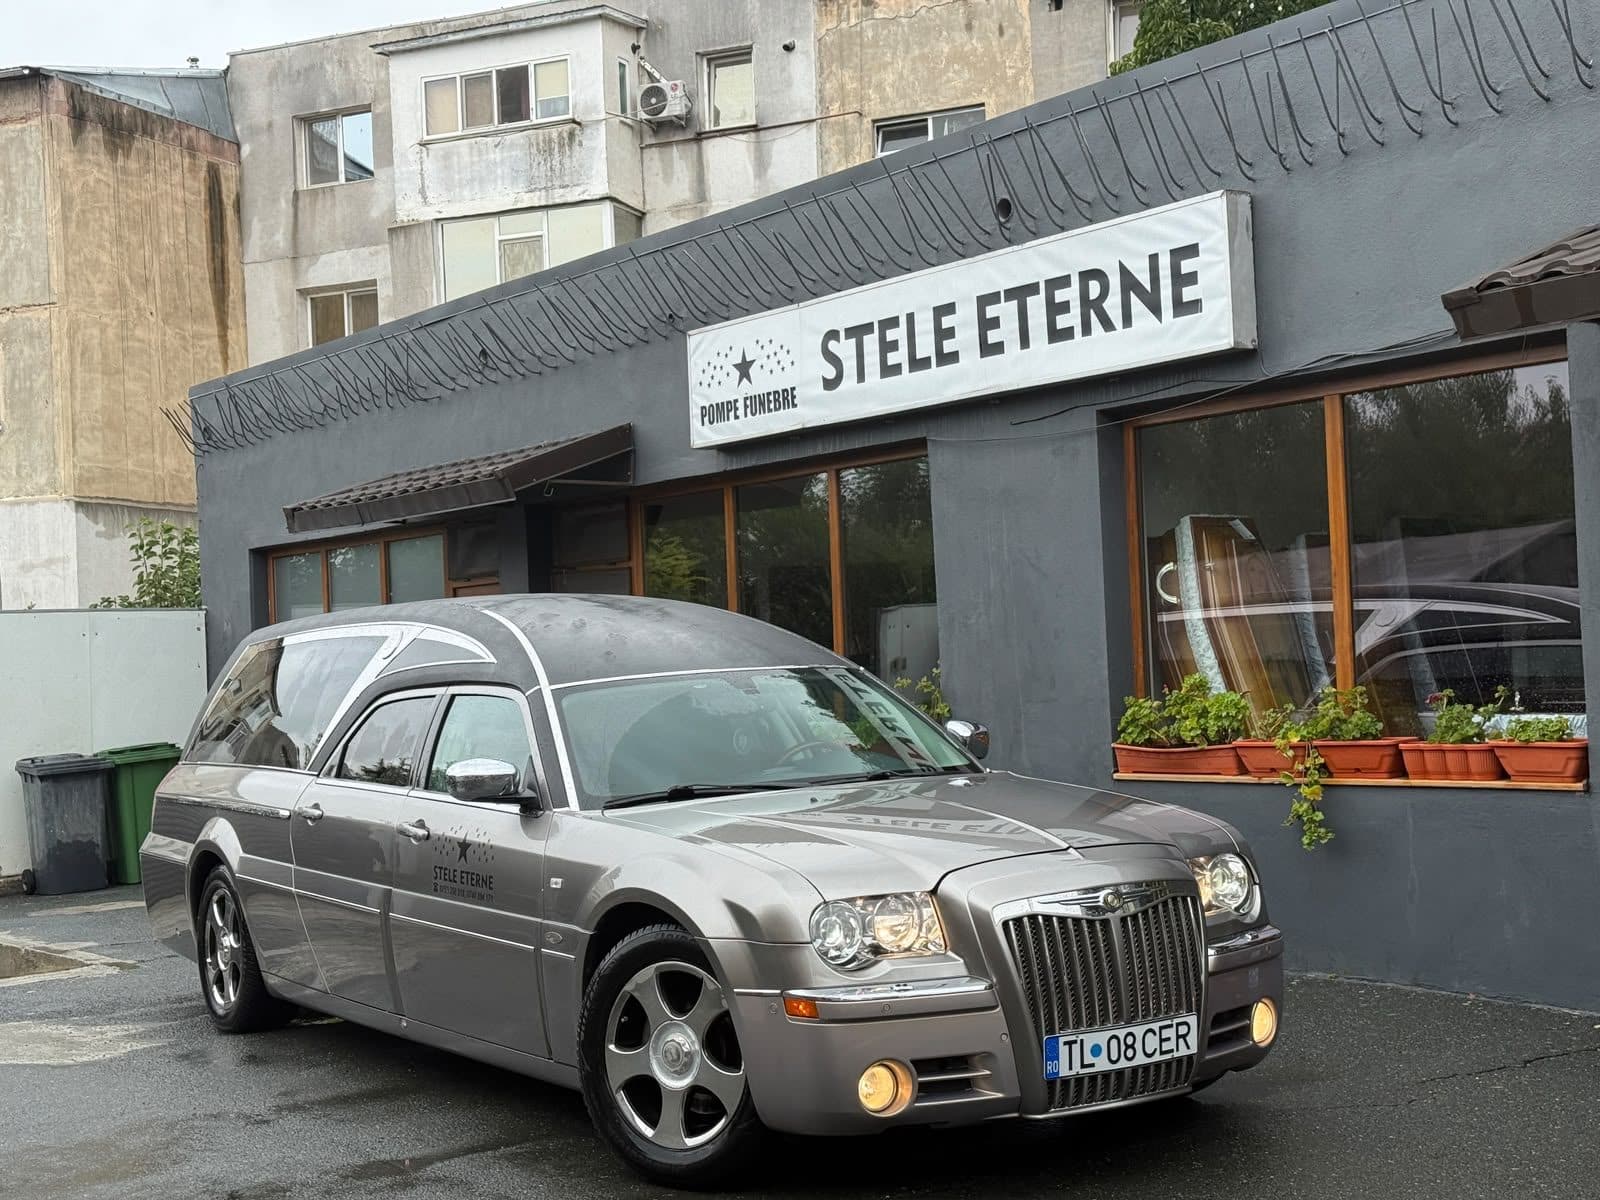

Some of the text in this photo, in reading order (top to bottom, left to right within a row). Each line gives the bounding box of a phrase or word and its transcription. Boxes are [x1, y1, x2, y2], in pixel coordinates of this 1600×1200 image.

[821, 243, 1203, 392] STELE ETERNE
[700, 386, 798, 427] POMPE FUNEBRE
[433, 865, 494, 891] STELE ETERNE
[1046, 1060, 1059, 1075] RO
[1063, 1039, 1096, 1071] TL
